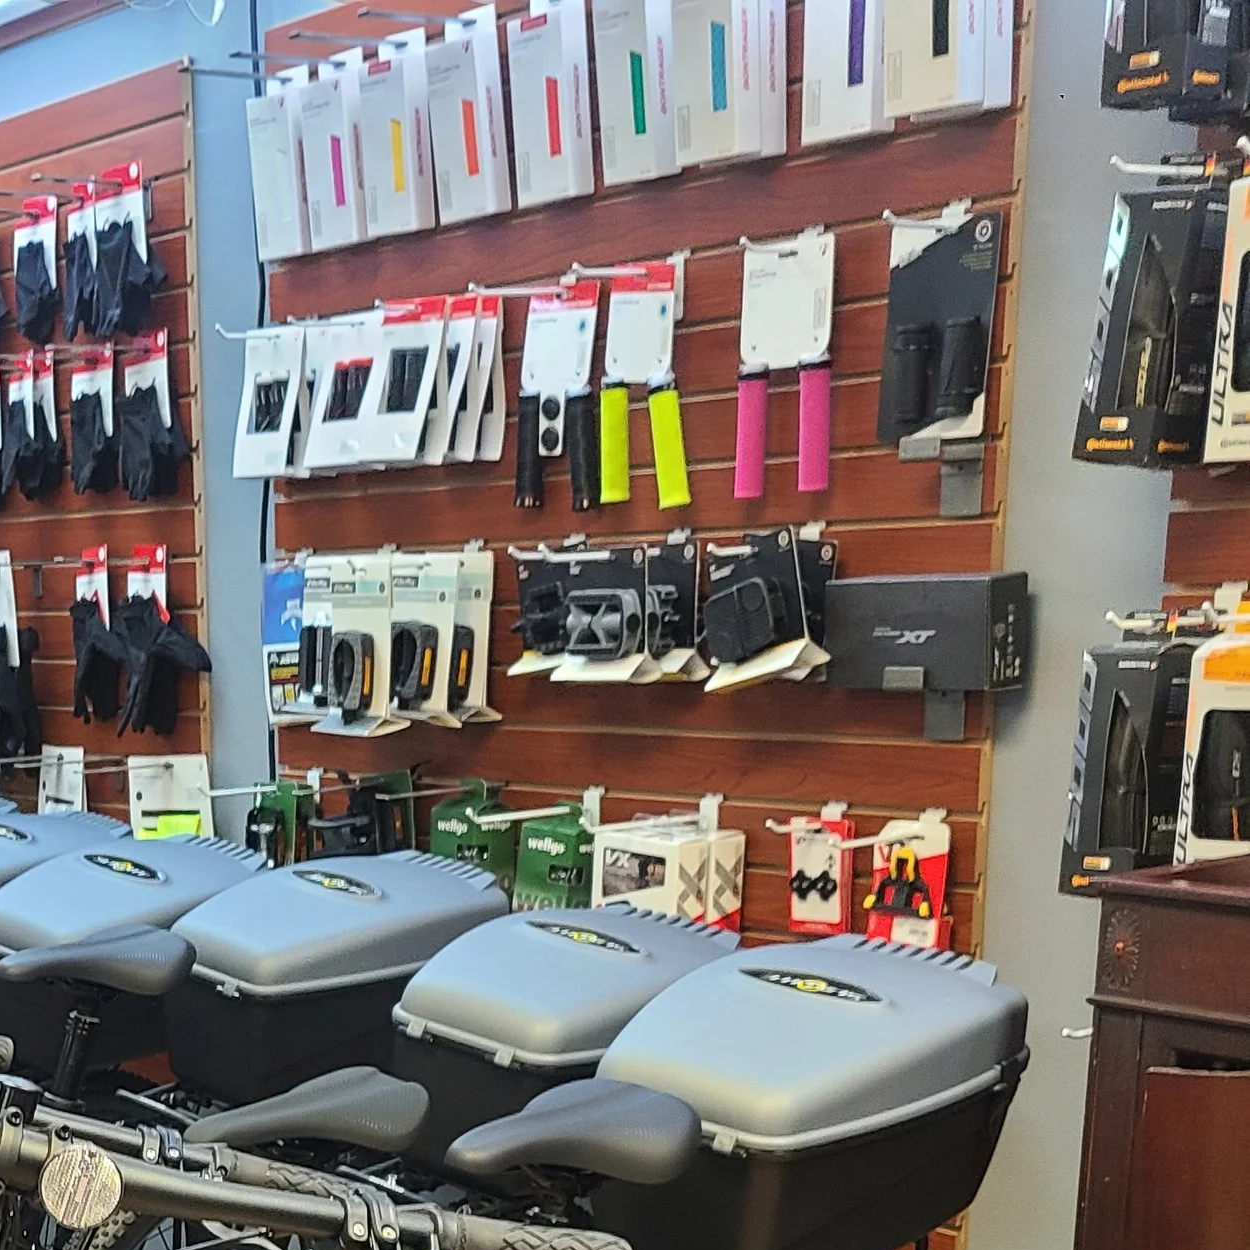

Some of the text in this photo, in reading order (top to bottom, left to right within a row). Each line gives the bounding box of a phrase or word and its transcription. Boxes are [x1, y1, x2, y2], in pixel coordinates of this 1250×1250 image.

[1211, 302, 1233, 425] ULTRA
[437, 818, 469, 836] wellgo
[527, 837, 566, 856] wellgo
[606, 849, 631, 868] VX
